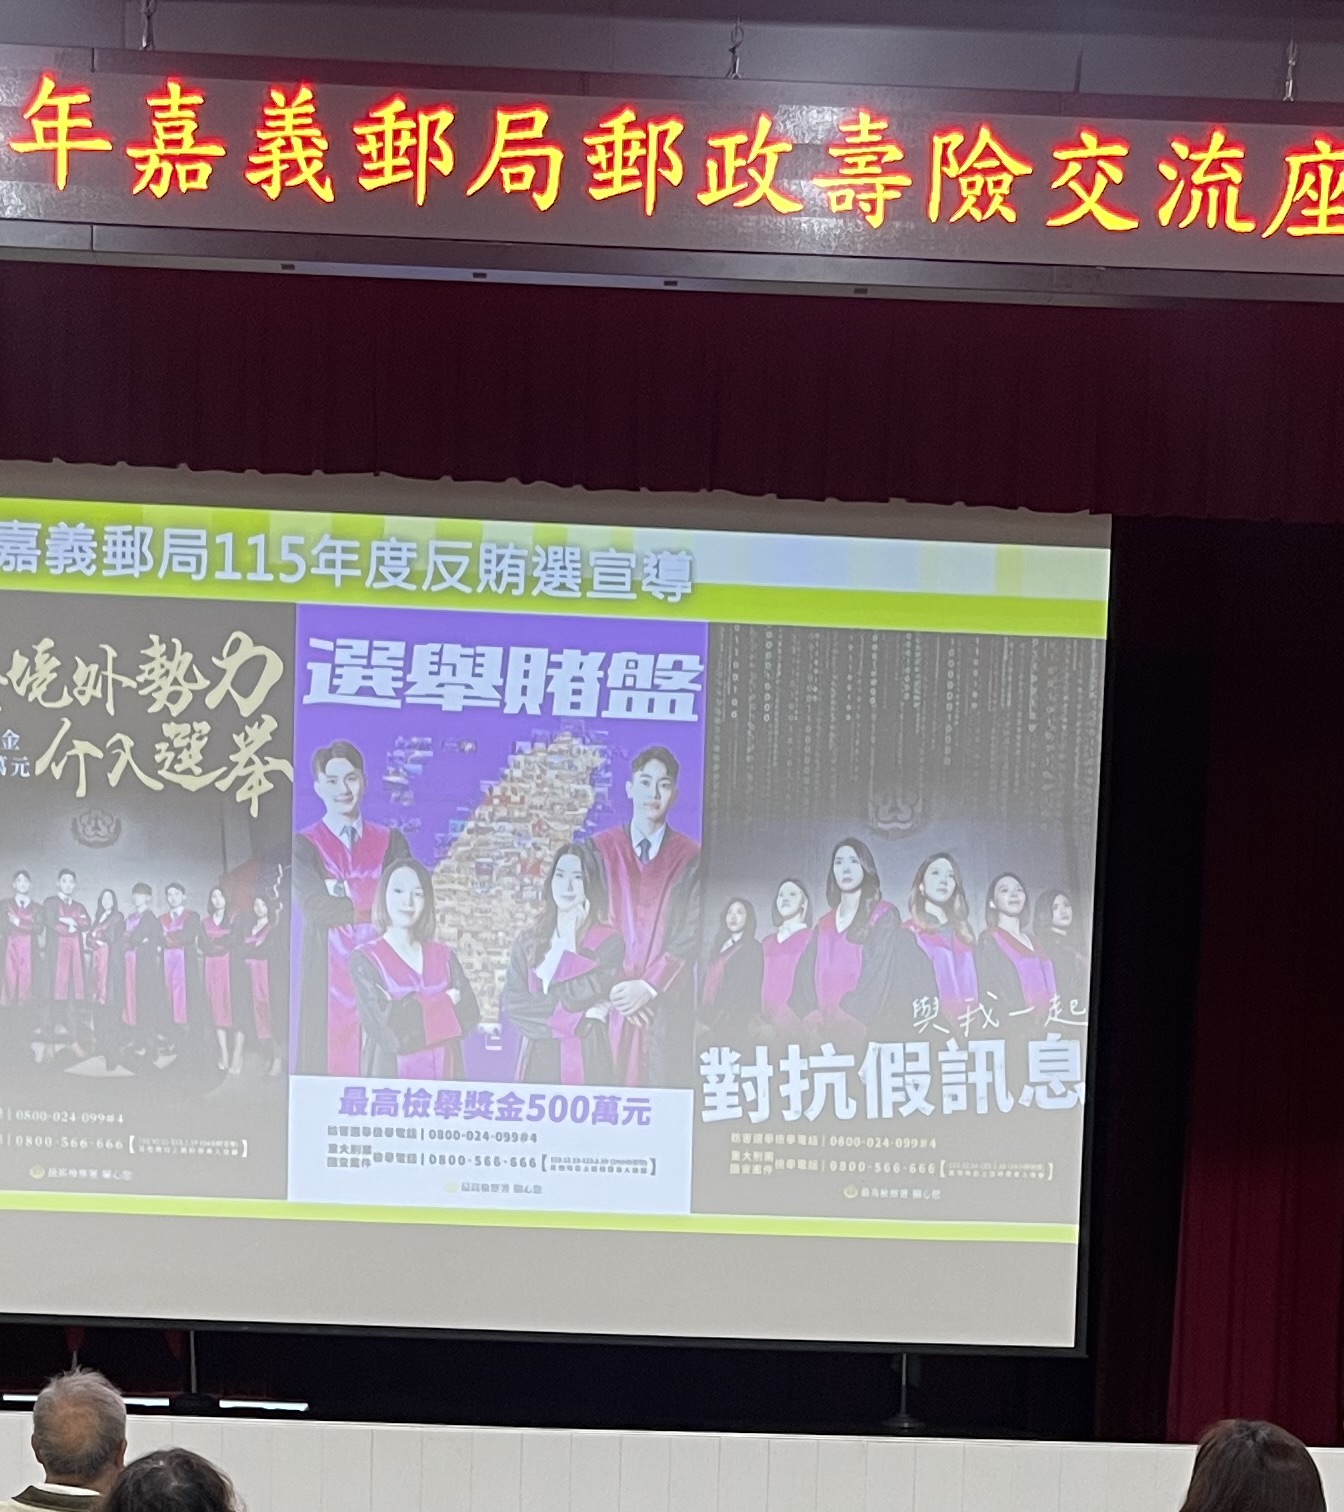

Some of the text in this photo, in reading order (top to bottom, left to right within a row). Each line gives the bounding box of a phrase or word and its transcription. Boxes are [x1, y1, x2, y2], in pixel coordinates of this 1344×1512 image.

[302, 637, 705, 722] 選舉賭盤
[338, 1085, 652, 1127] 最高檢舉獎金500萬元
[699, 1033, 1086, 1124] 對抗假訊息
